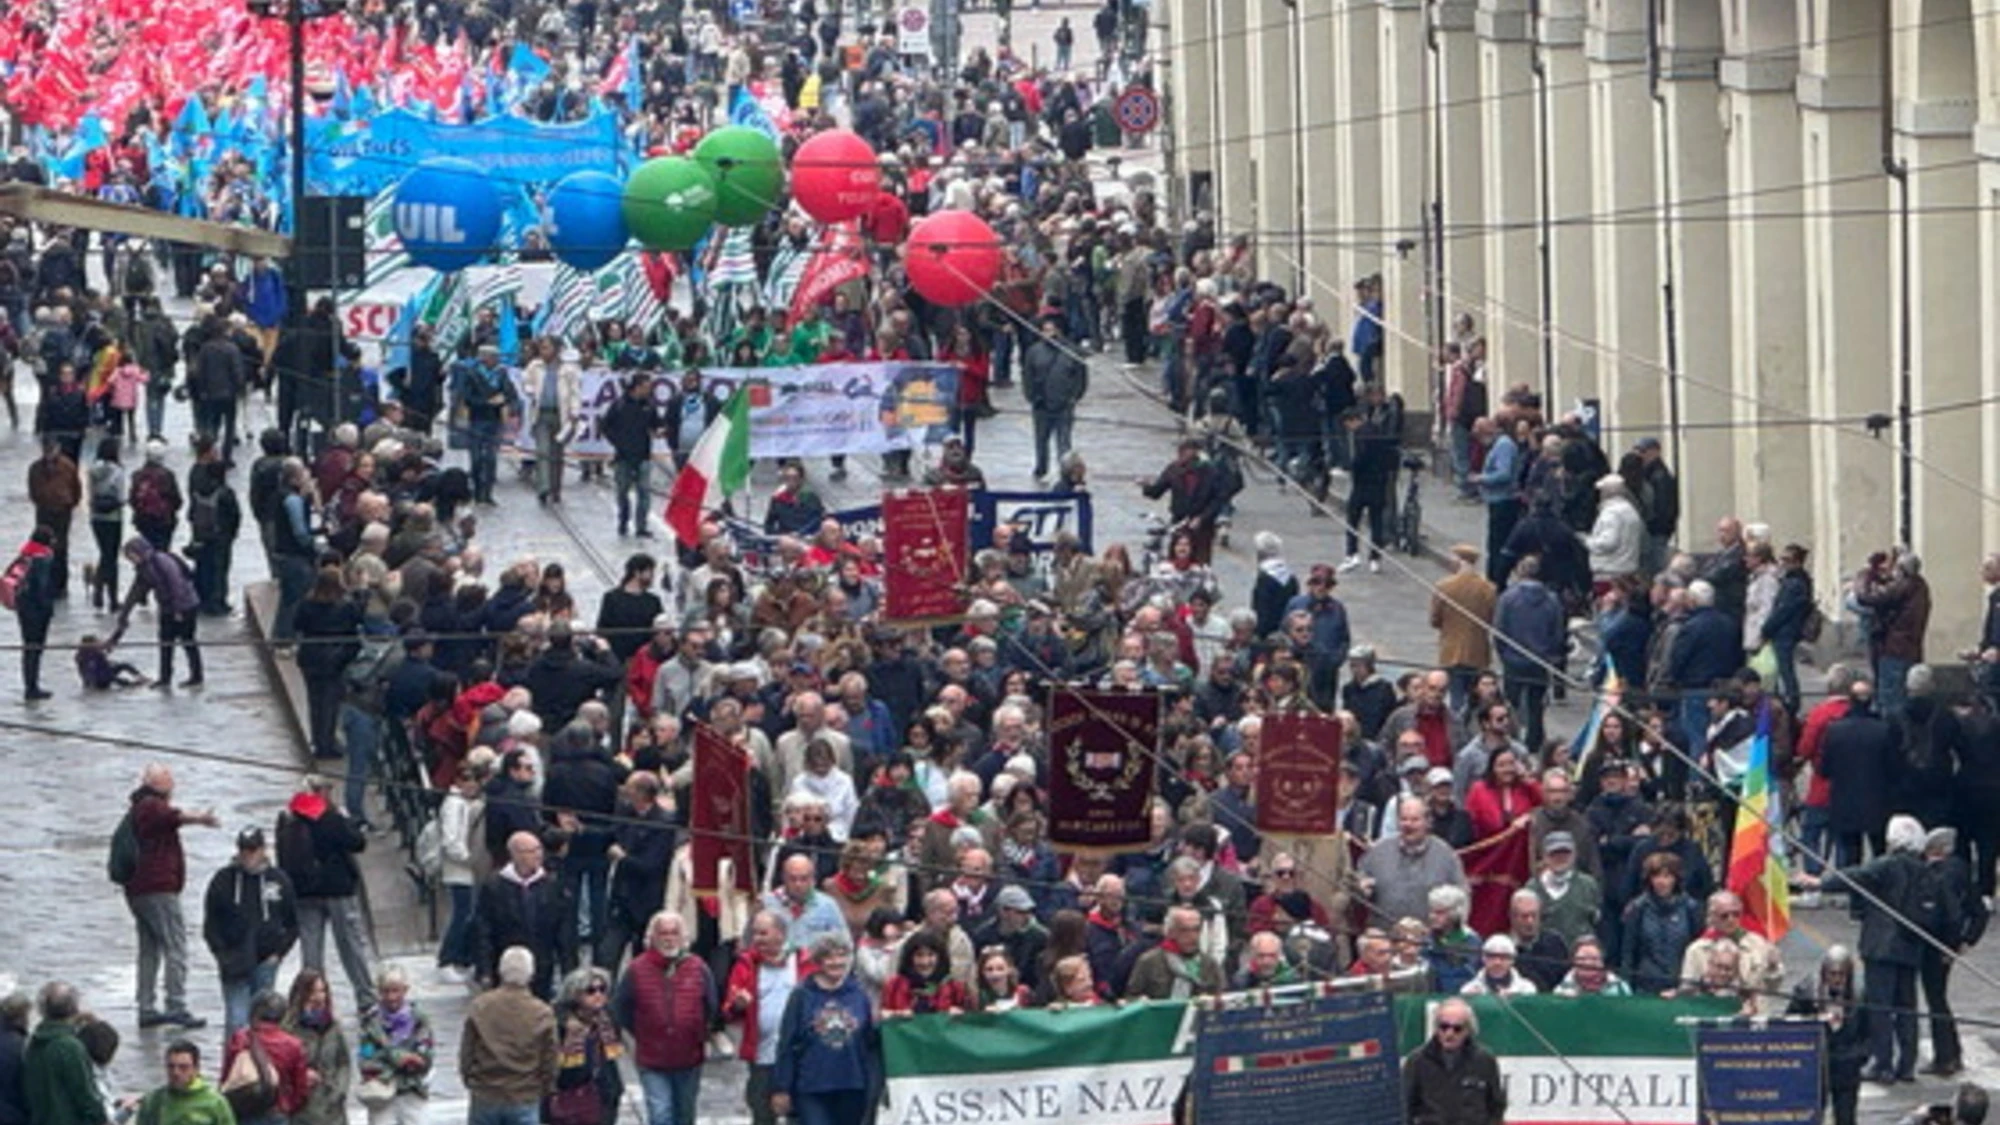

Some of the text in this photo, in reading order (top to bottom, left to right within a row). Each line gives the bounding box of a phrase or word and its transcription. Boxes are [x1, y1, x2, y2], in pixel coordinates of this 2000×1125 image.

[396, 202, 466, 243] UIL
[901, 1083, 1062, 1125] ASS.NE
[1078, 1076, 1167, 1115] NAZ
[1529, 1073, 1692, 1108] D'ITALI
